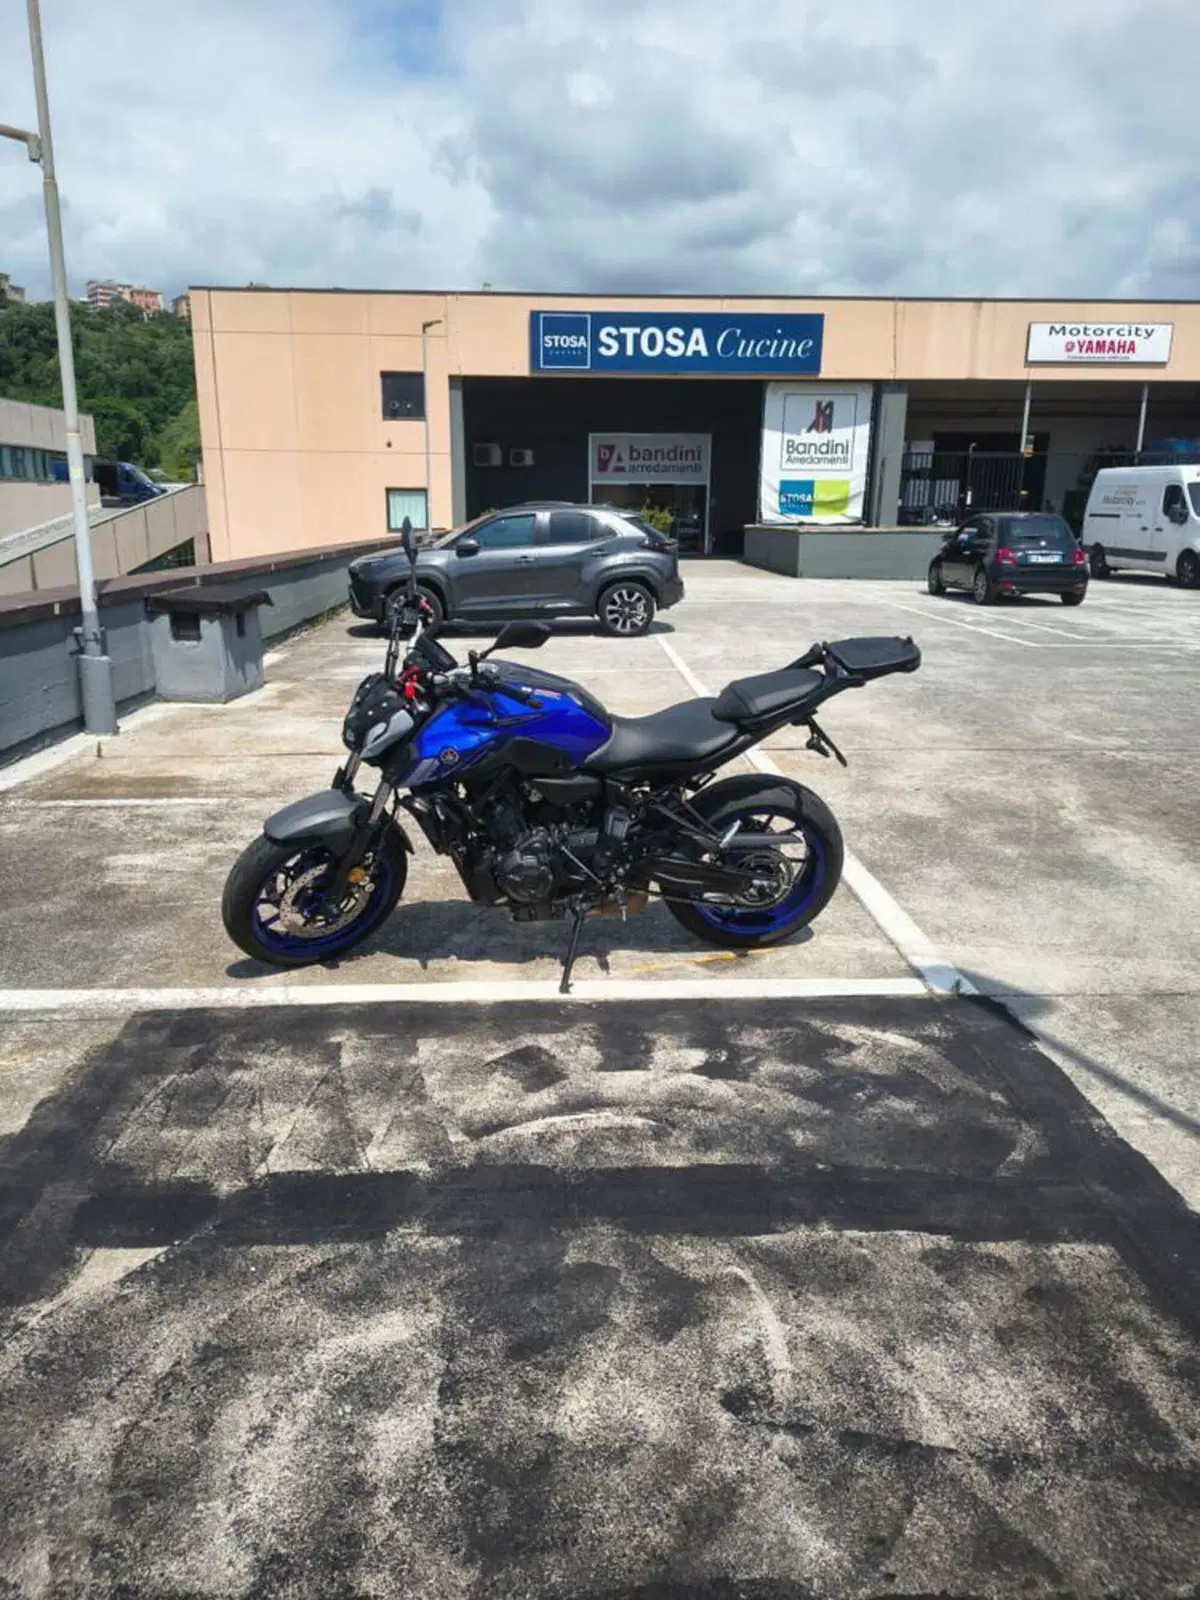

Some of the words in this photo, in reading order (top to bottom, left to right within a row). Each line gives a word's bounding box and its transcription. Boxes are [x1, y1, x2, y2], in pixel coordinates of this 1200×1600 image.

[1049, 325, 1155, 339] Motorcity
[544, 335, 587, 348] STOSA
[598, 326, 709, 357] STOSA
[716, 327, 813, 358] Cucine
[1077, 340, 1136, 354] YAMAHA
[629, 444, 702, 462] bandini
[786, 439, 849, 455] Bandini
